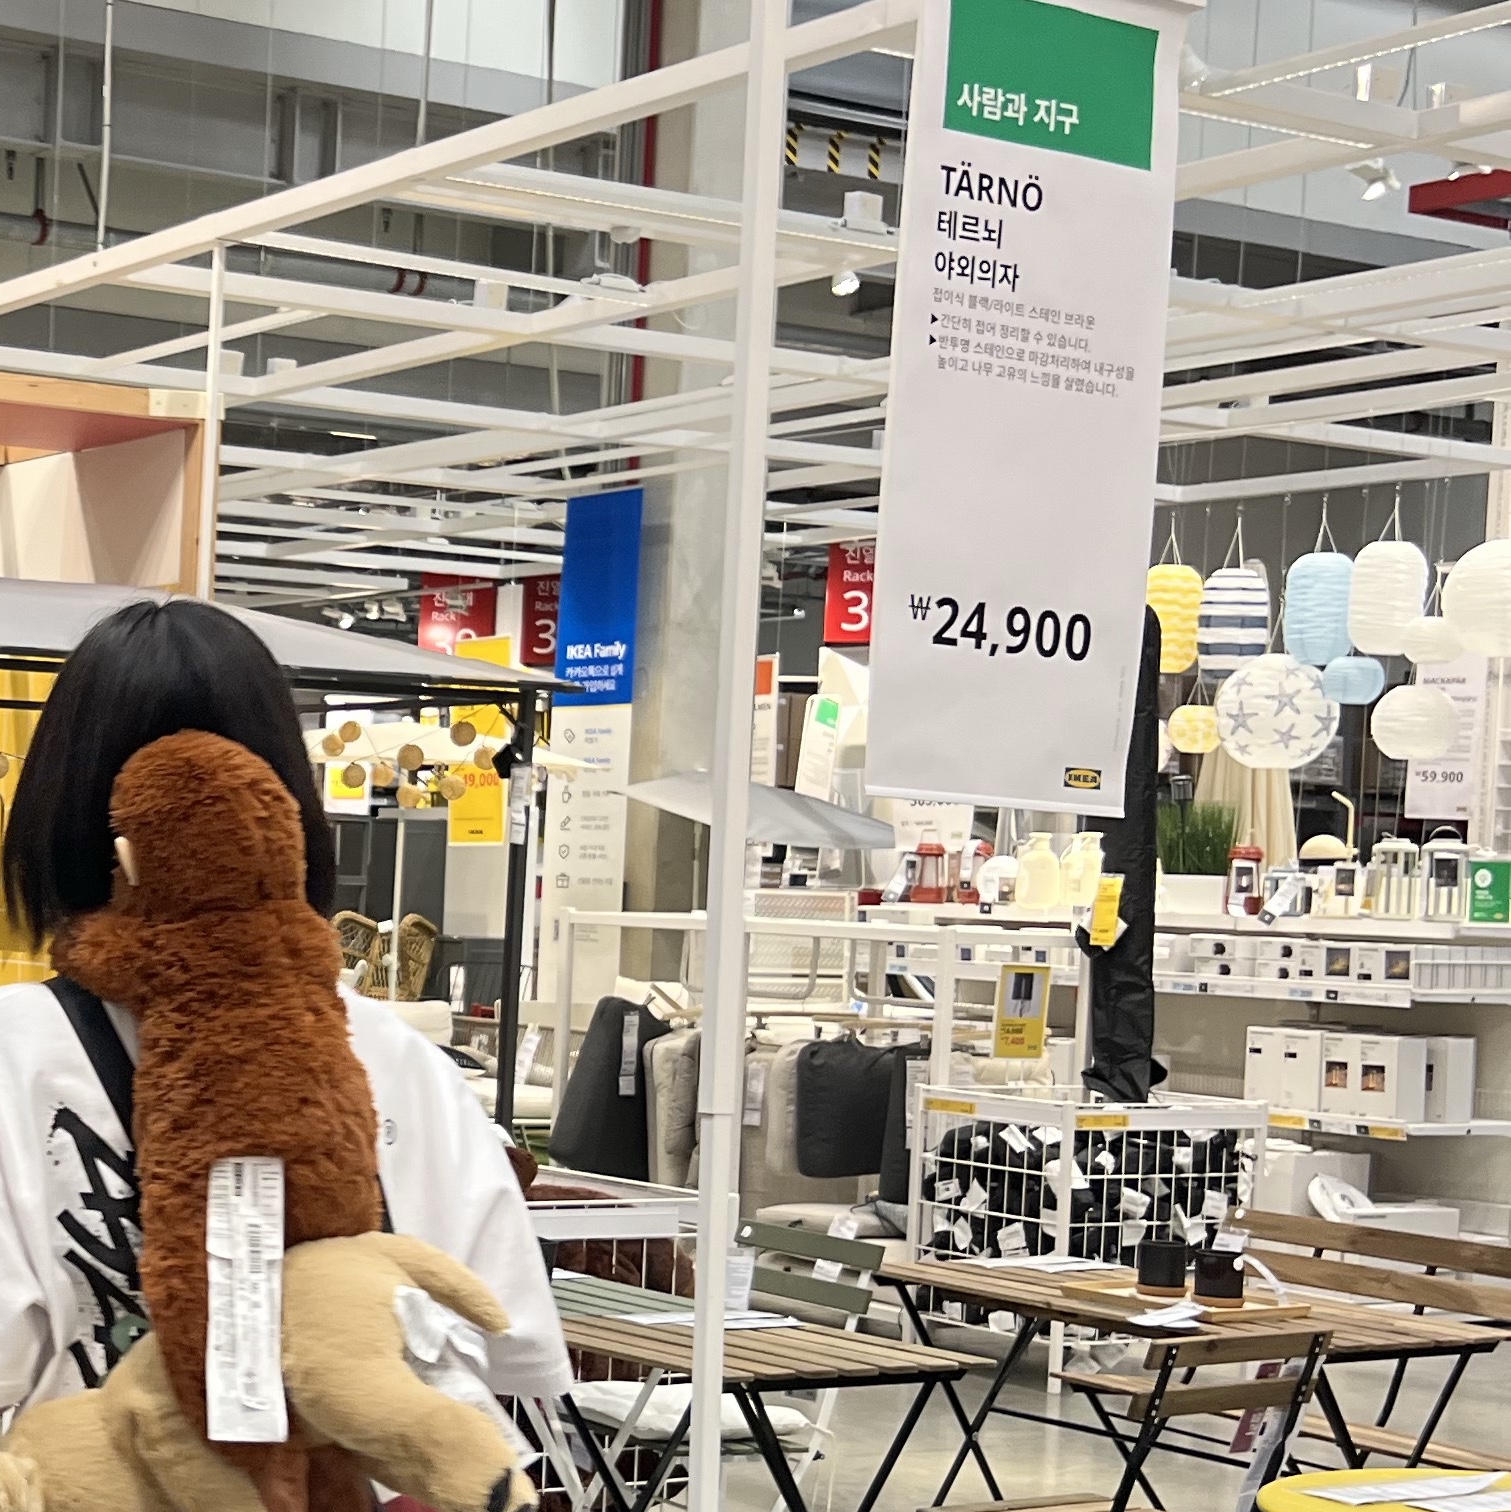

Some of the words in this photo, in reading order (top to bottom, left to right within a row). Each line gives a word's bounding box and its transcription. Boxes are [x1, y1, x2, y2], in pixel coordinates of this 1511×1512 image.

[957, 83, 1028, 126] 사람과
[1033, 99, 1080, 135] 지구
[941, 160, 1043, 212] TÄRNÖ
[937, 210, 1003, 249] 테르뇌
[935, 251, 1019, 293] 야외의자
[932, 287, 965, 306] 접이식
[1028, 307, 1061, 324] 스테인
[1064, 312, 1095, 330] 브라운
[940, 314, 972, 332] 간단히
[1033, 331, 1043, 345] 수
[938, 335, 970, 353] 반투명
[973, 341, 1025, 362] 스테인으로
[1028, 351, 1091, 373] 마감처리하여
[938, 354, 969, 372] 높이고
[972, 361, 992, 377] 나무
[996, 366, 1027, 383] 고유의
[843, 570, 874, 582] Rack
[431, 611, 456, 621] Rack
[840, 589, 869, 632] 3
[909, 594, 1092, 661] ₩24,900
[566, 643, 592, 659] IKEA
[593, 641, 626, 660] Family
